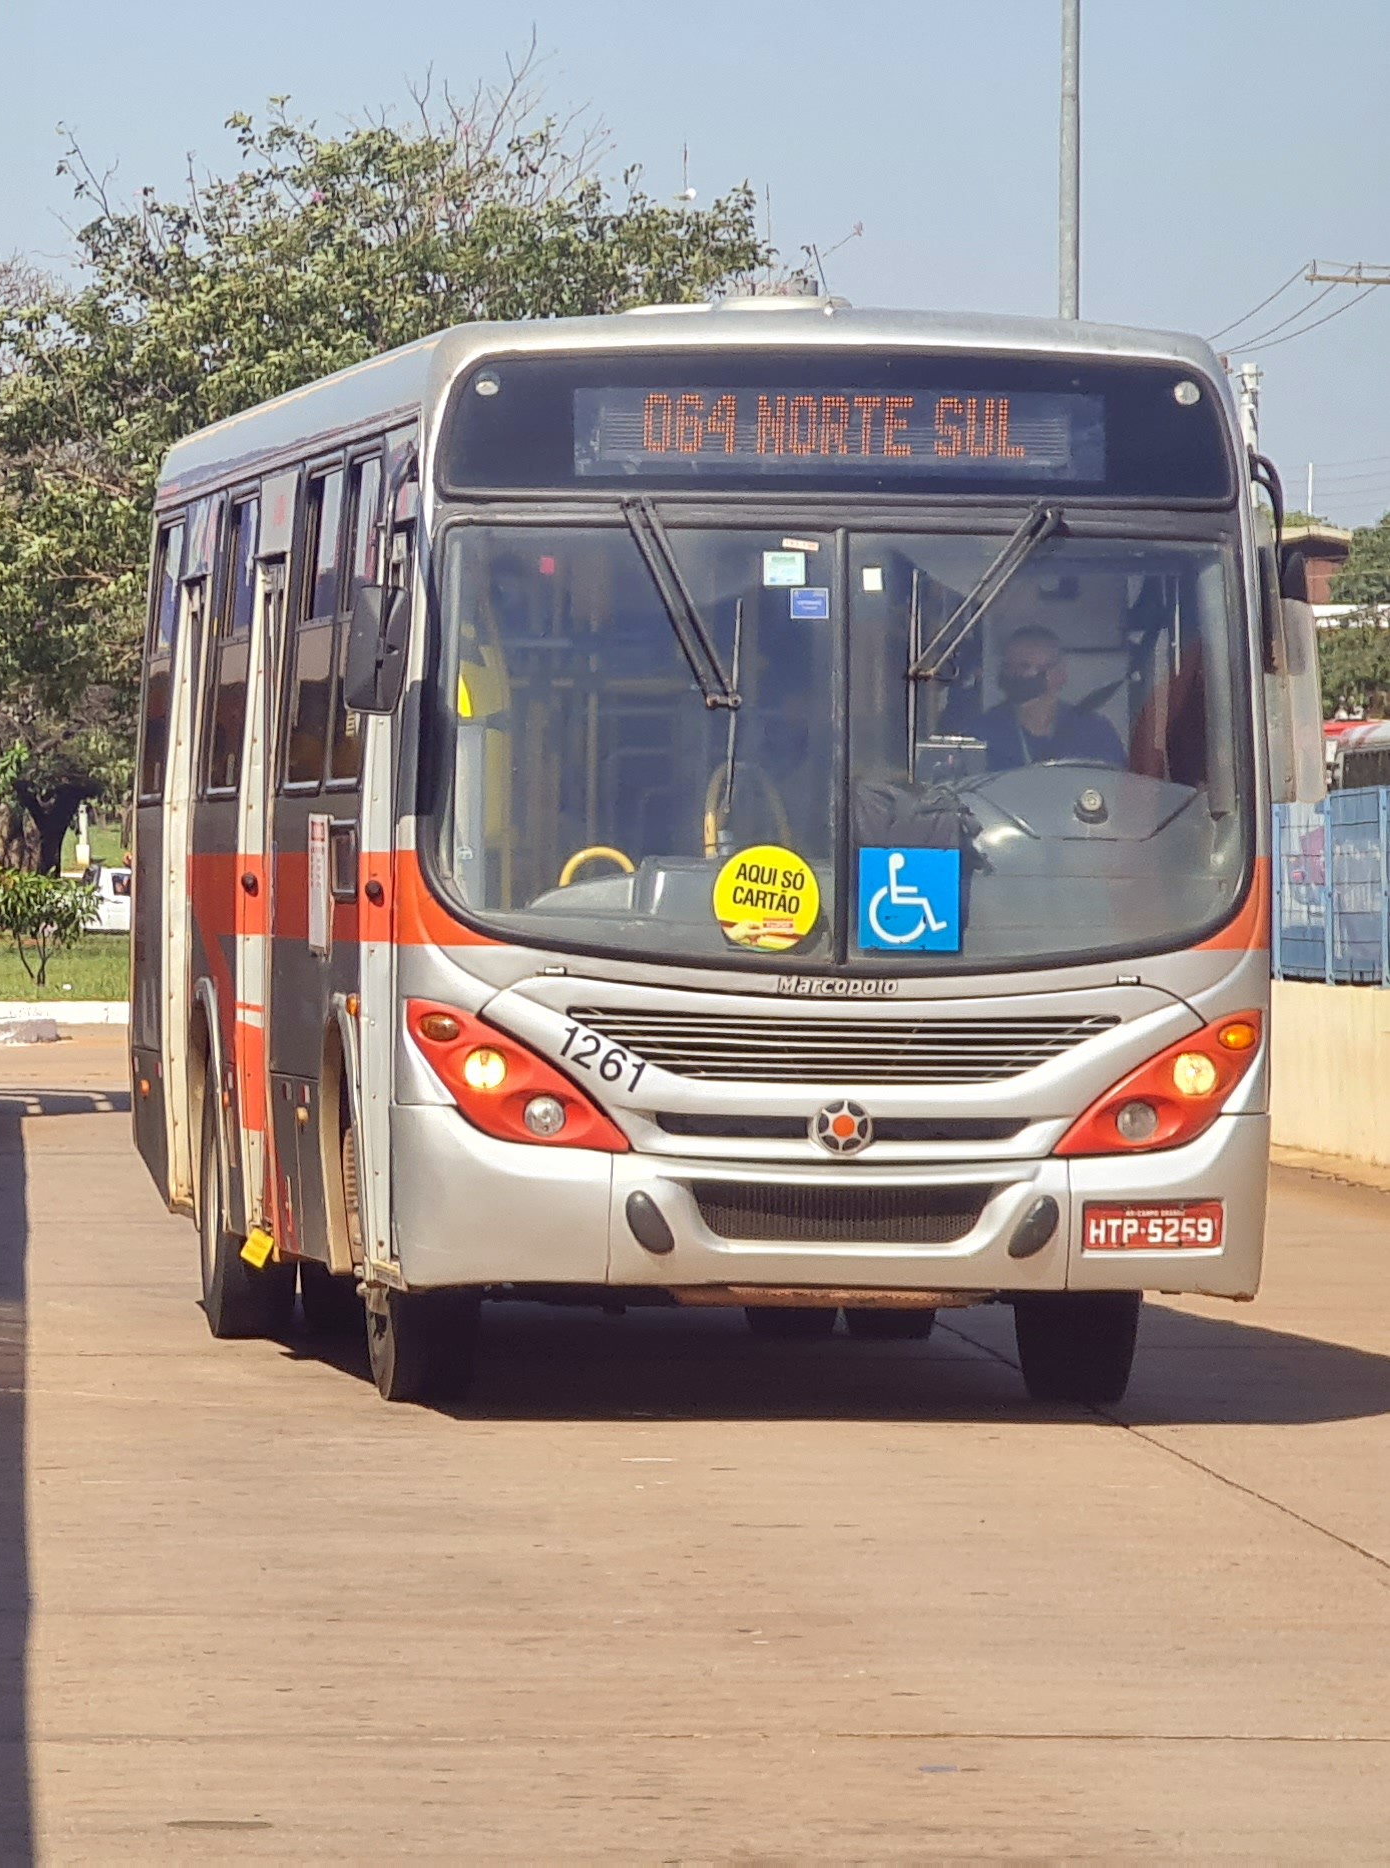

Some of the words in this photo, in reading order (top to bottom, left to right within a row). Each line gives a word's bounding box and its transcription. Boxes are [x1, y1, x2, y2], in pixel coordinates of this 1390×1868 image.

[642, 393, 736, 454] 064
[755, 395, 914, 457] NORTE
[933, 397, 1025, 458] SUL
[735, 863, 778, 885] AQUI
[780, 869, 805, 890] SÓ
[732, 886, 800, 914] CARTÃO
[777, 976, 898, 995] Marcopolo
[559, 1026, 646, 1093] 1261
